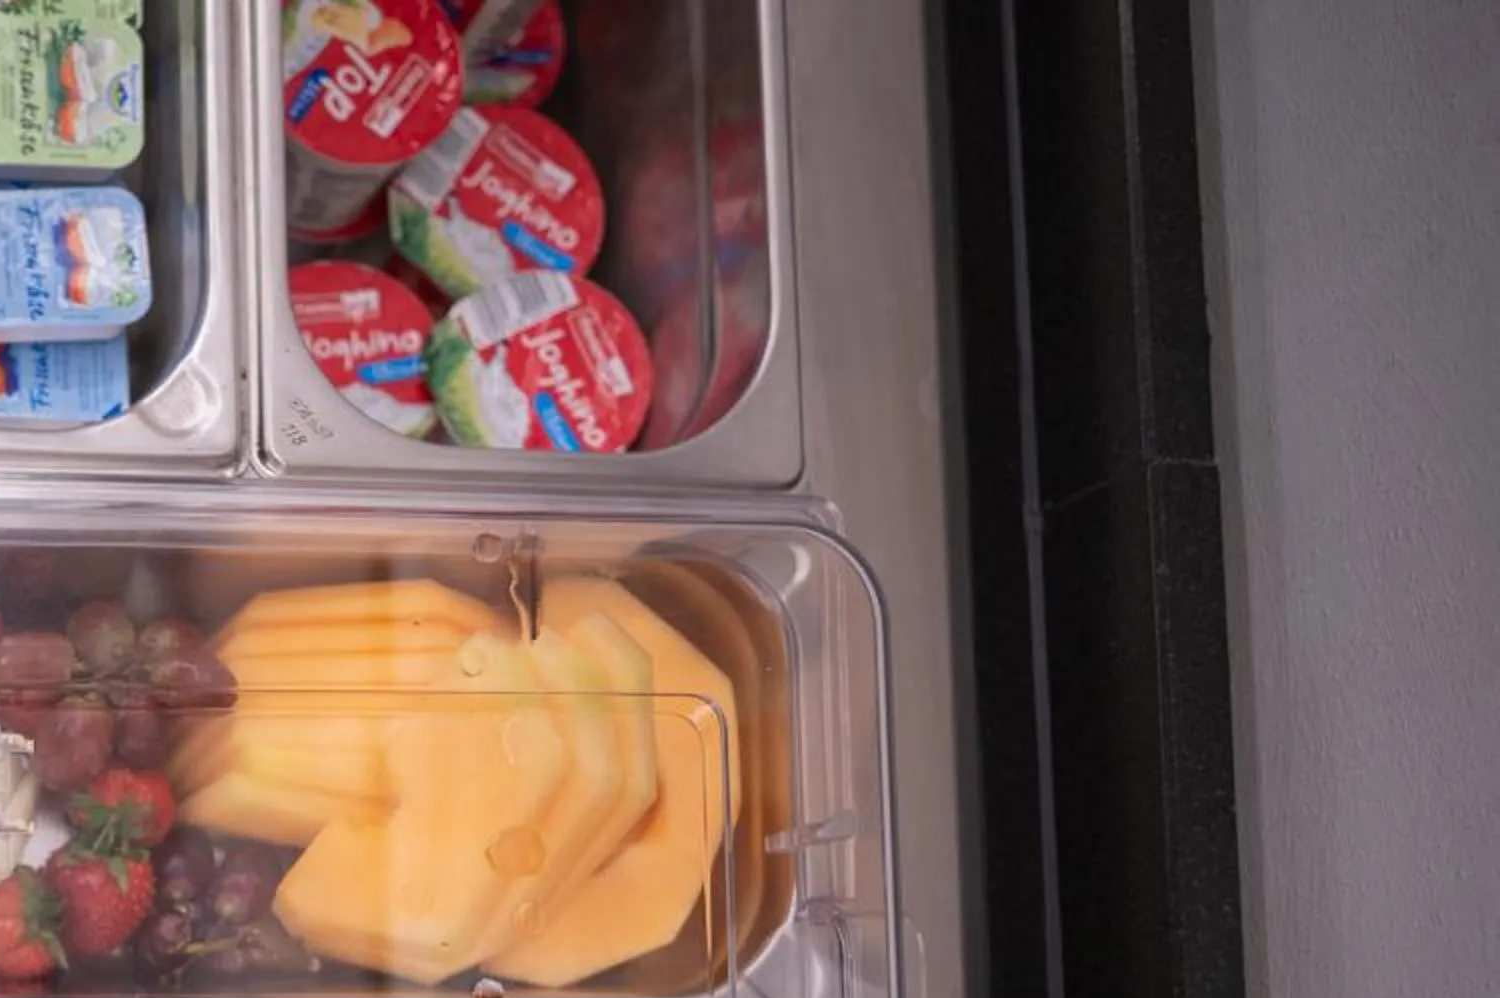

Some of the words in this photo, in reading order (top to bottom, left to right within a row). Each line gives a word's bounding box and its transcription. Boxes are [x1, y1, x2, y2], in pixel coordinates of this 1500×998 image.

[319, 43, 393, 122] Top
[461, 158, 580, 250] Joghino
[520, 328, 607, 449] Joghino
